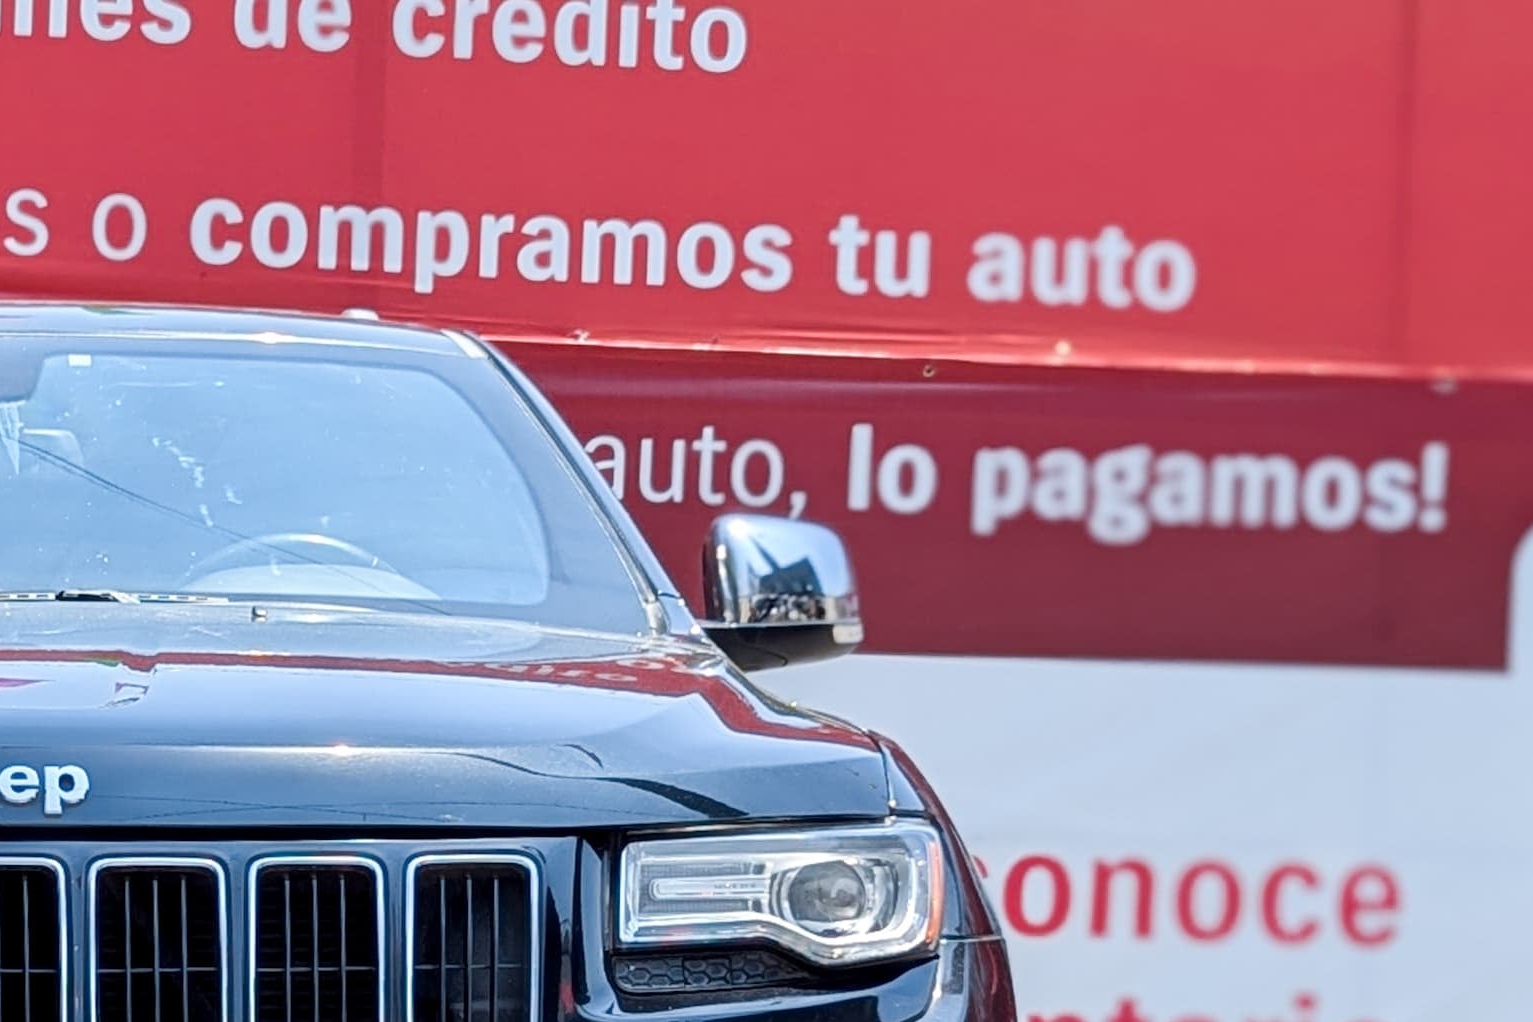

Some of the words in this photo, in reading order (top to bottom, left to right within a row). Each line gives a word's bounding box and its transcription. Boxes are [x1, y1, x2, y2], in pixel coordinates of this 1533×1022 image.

[234, 0, 353, 52] de
[92, 193, 147, 262] o
[190, 198, 793, 294] compramos
[829, 215, 931, 297] tu
[967, 226, 1196, 311] auto
[847, 423, 937, 513] lo
[972, 442, 1448, 545] pagamos!
[970, 853, 1400, 946] onoce
